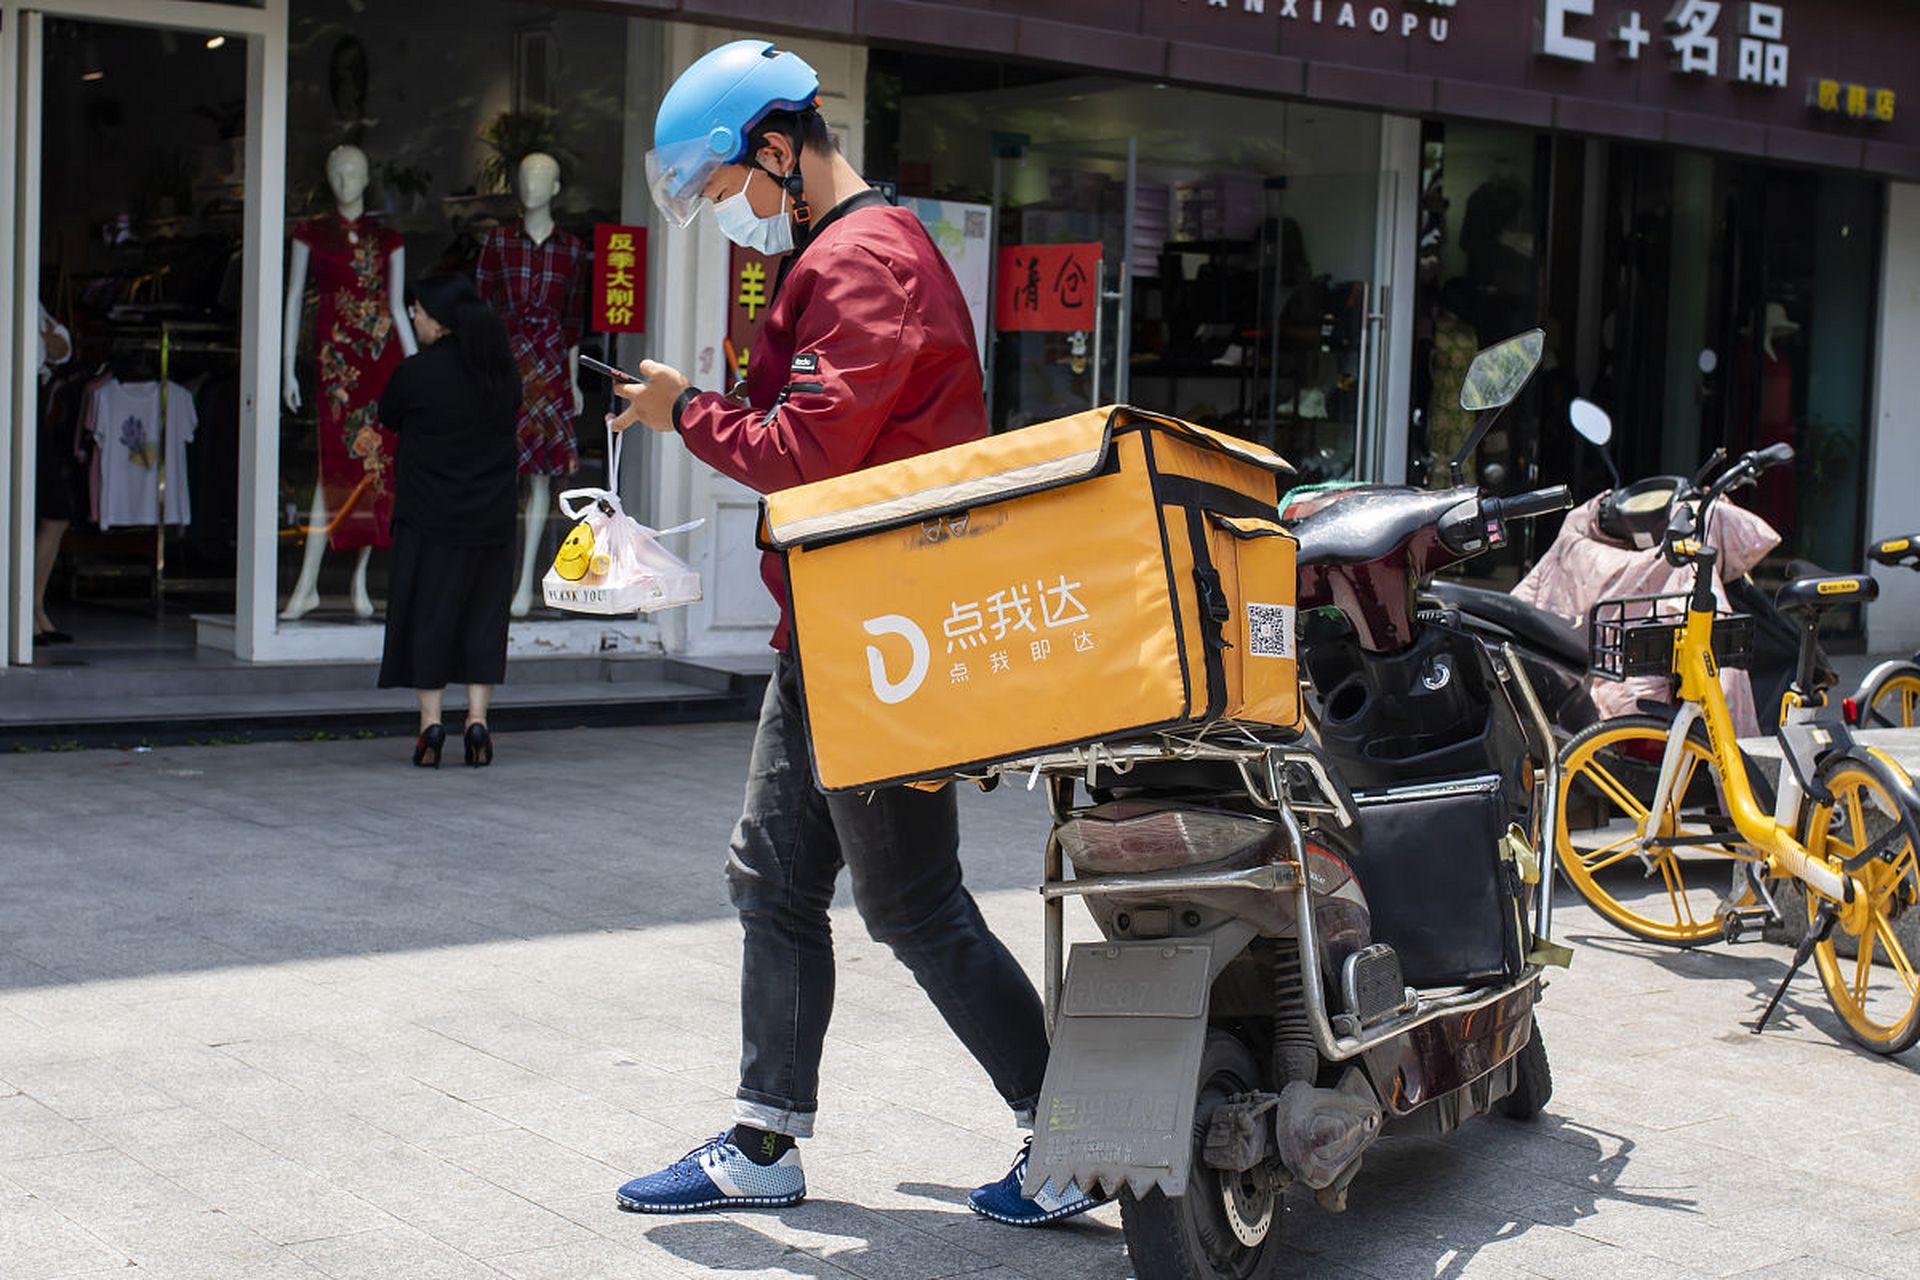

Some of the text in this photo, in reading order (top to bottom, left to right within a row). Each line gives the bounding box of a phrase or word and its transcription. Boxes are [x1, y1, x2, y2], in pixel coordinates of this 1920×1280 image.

[606, 233, 636, 326] 反季大削价
[1014, 254, 1087, 312] 清仓
[943, 575, 1089, 654] 点我达
[950, 630, 1095, 684] 点我即达
